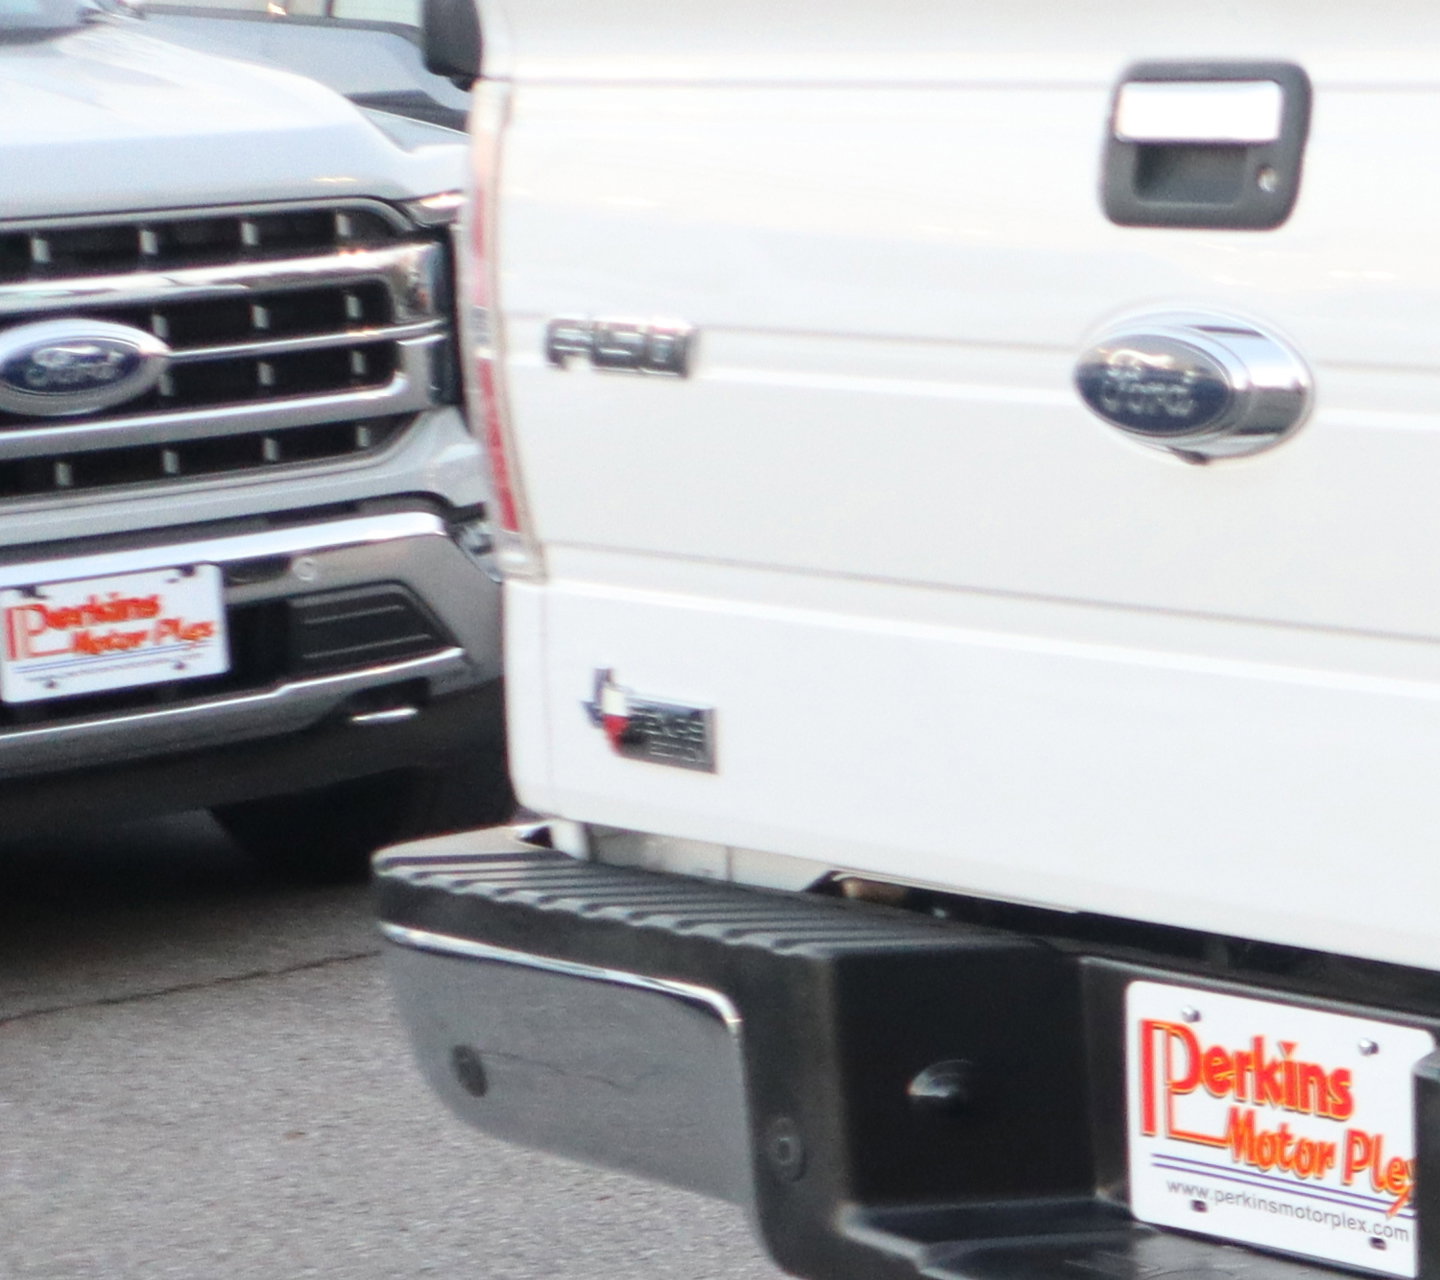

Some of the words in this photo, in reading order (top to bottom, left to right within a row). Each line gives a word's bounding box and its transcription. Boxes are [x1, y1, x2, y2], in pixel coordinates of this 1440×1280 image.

[1102, 348, 1198, 418] Ford
[5, 593, 162, 661] Perkins
[1140, 1018, 1355, 1136] Perkins
[1227, 1103, 1337, 1181] Motor
[1166, 1179, 1410, 1242] www.perkinsmotorplex.com
